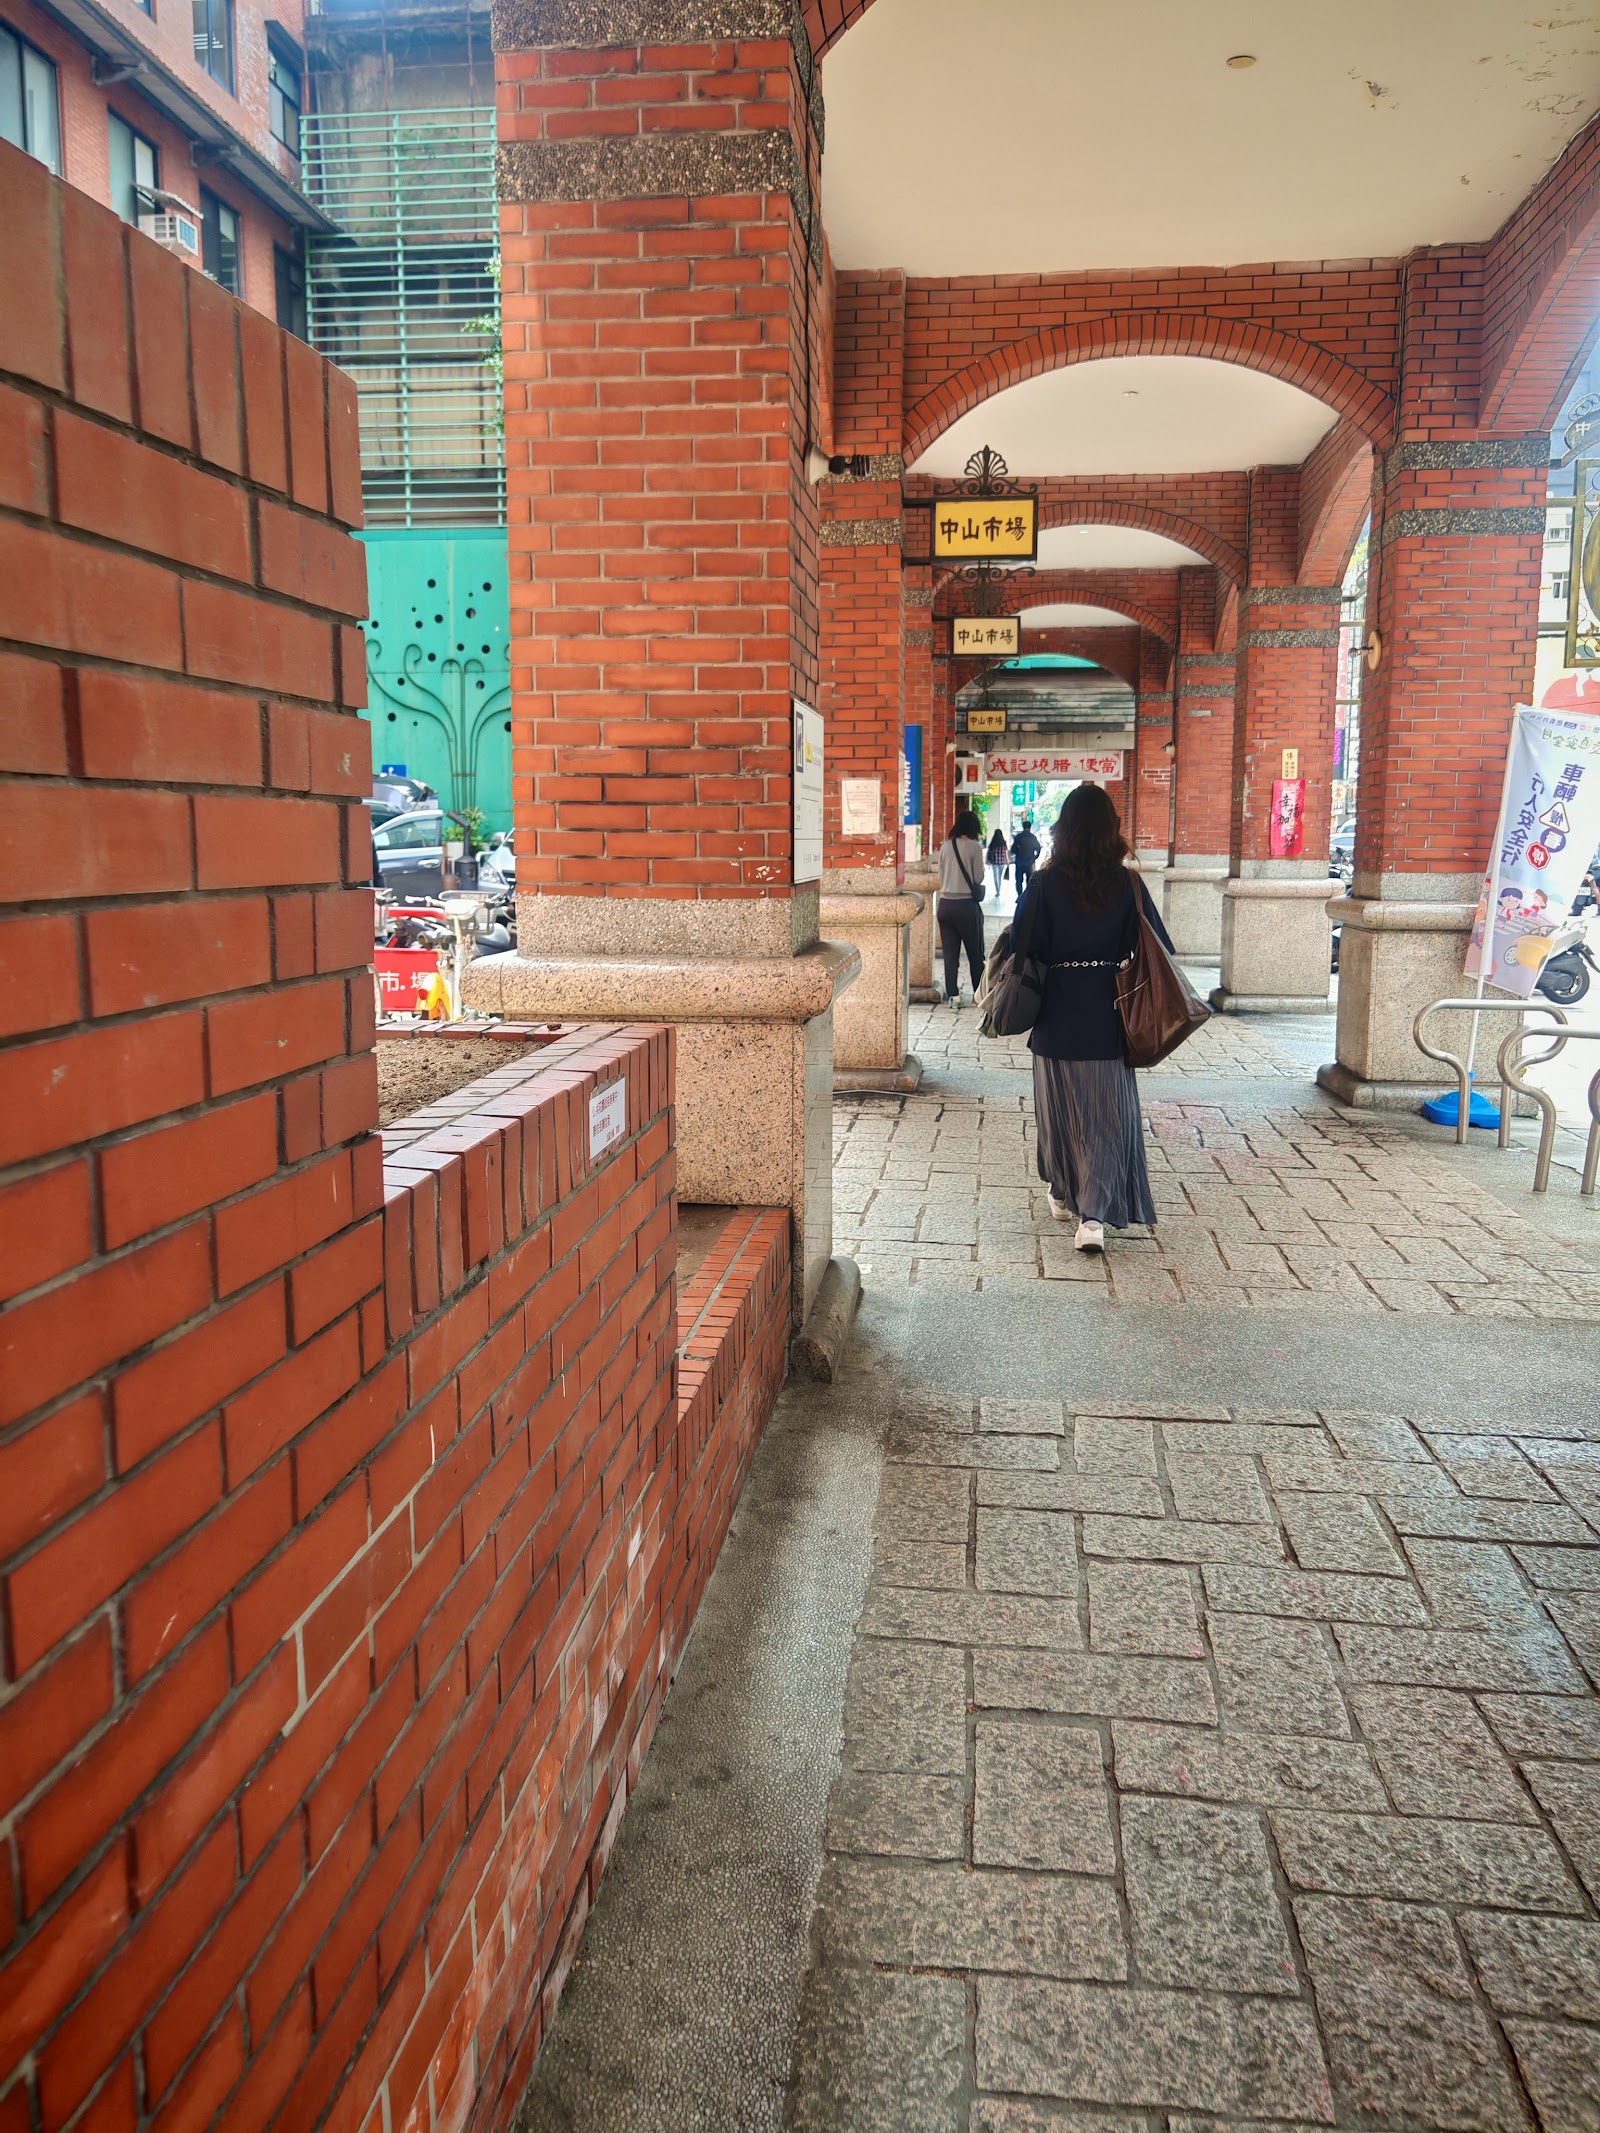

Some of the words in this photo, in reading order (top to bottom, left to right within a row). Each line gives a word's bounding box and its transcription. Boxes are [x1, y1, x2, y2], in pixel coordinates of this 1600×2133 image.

[940, 516, 1027, 543] 中山市場
[957, 628, 1015, 646] 中山市場
[969, 715, 1003, 727] 中山市場
